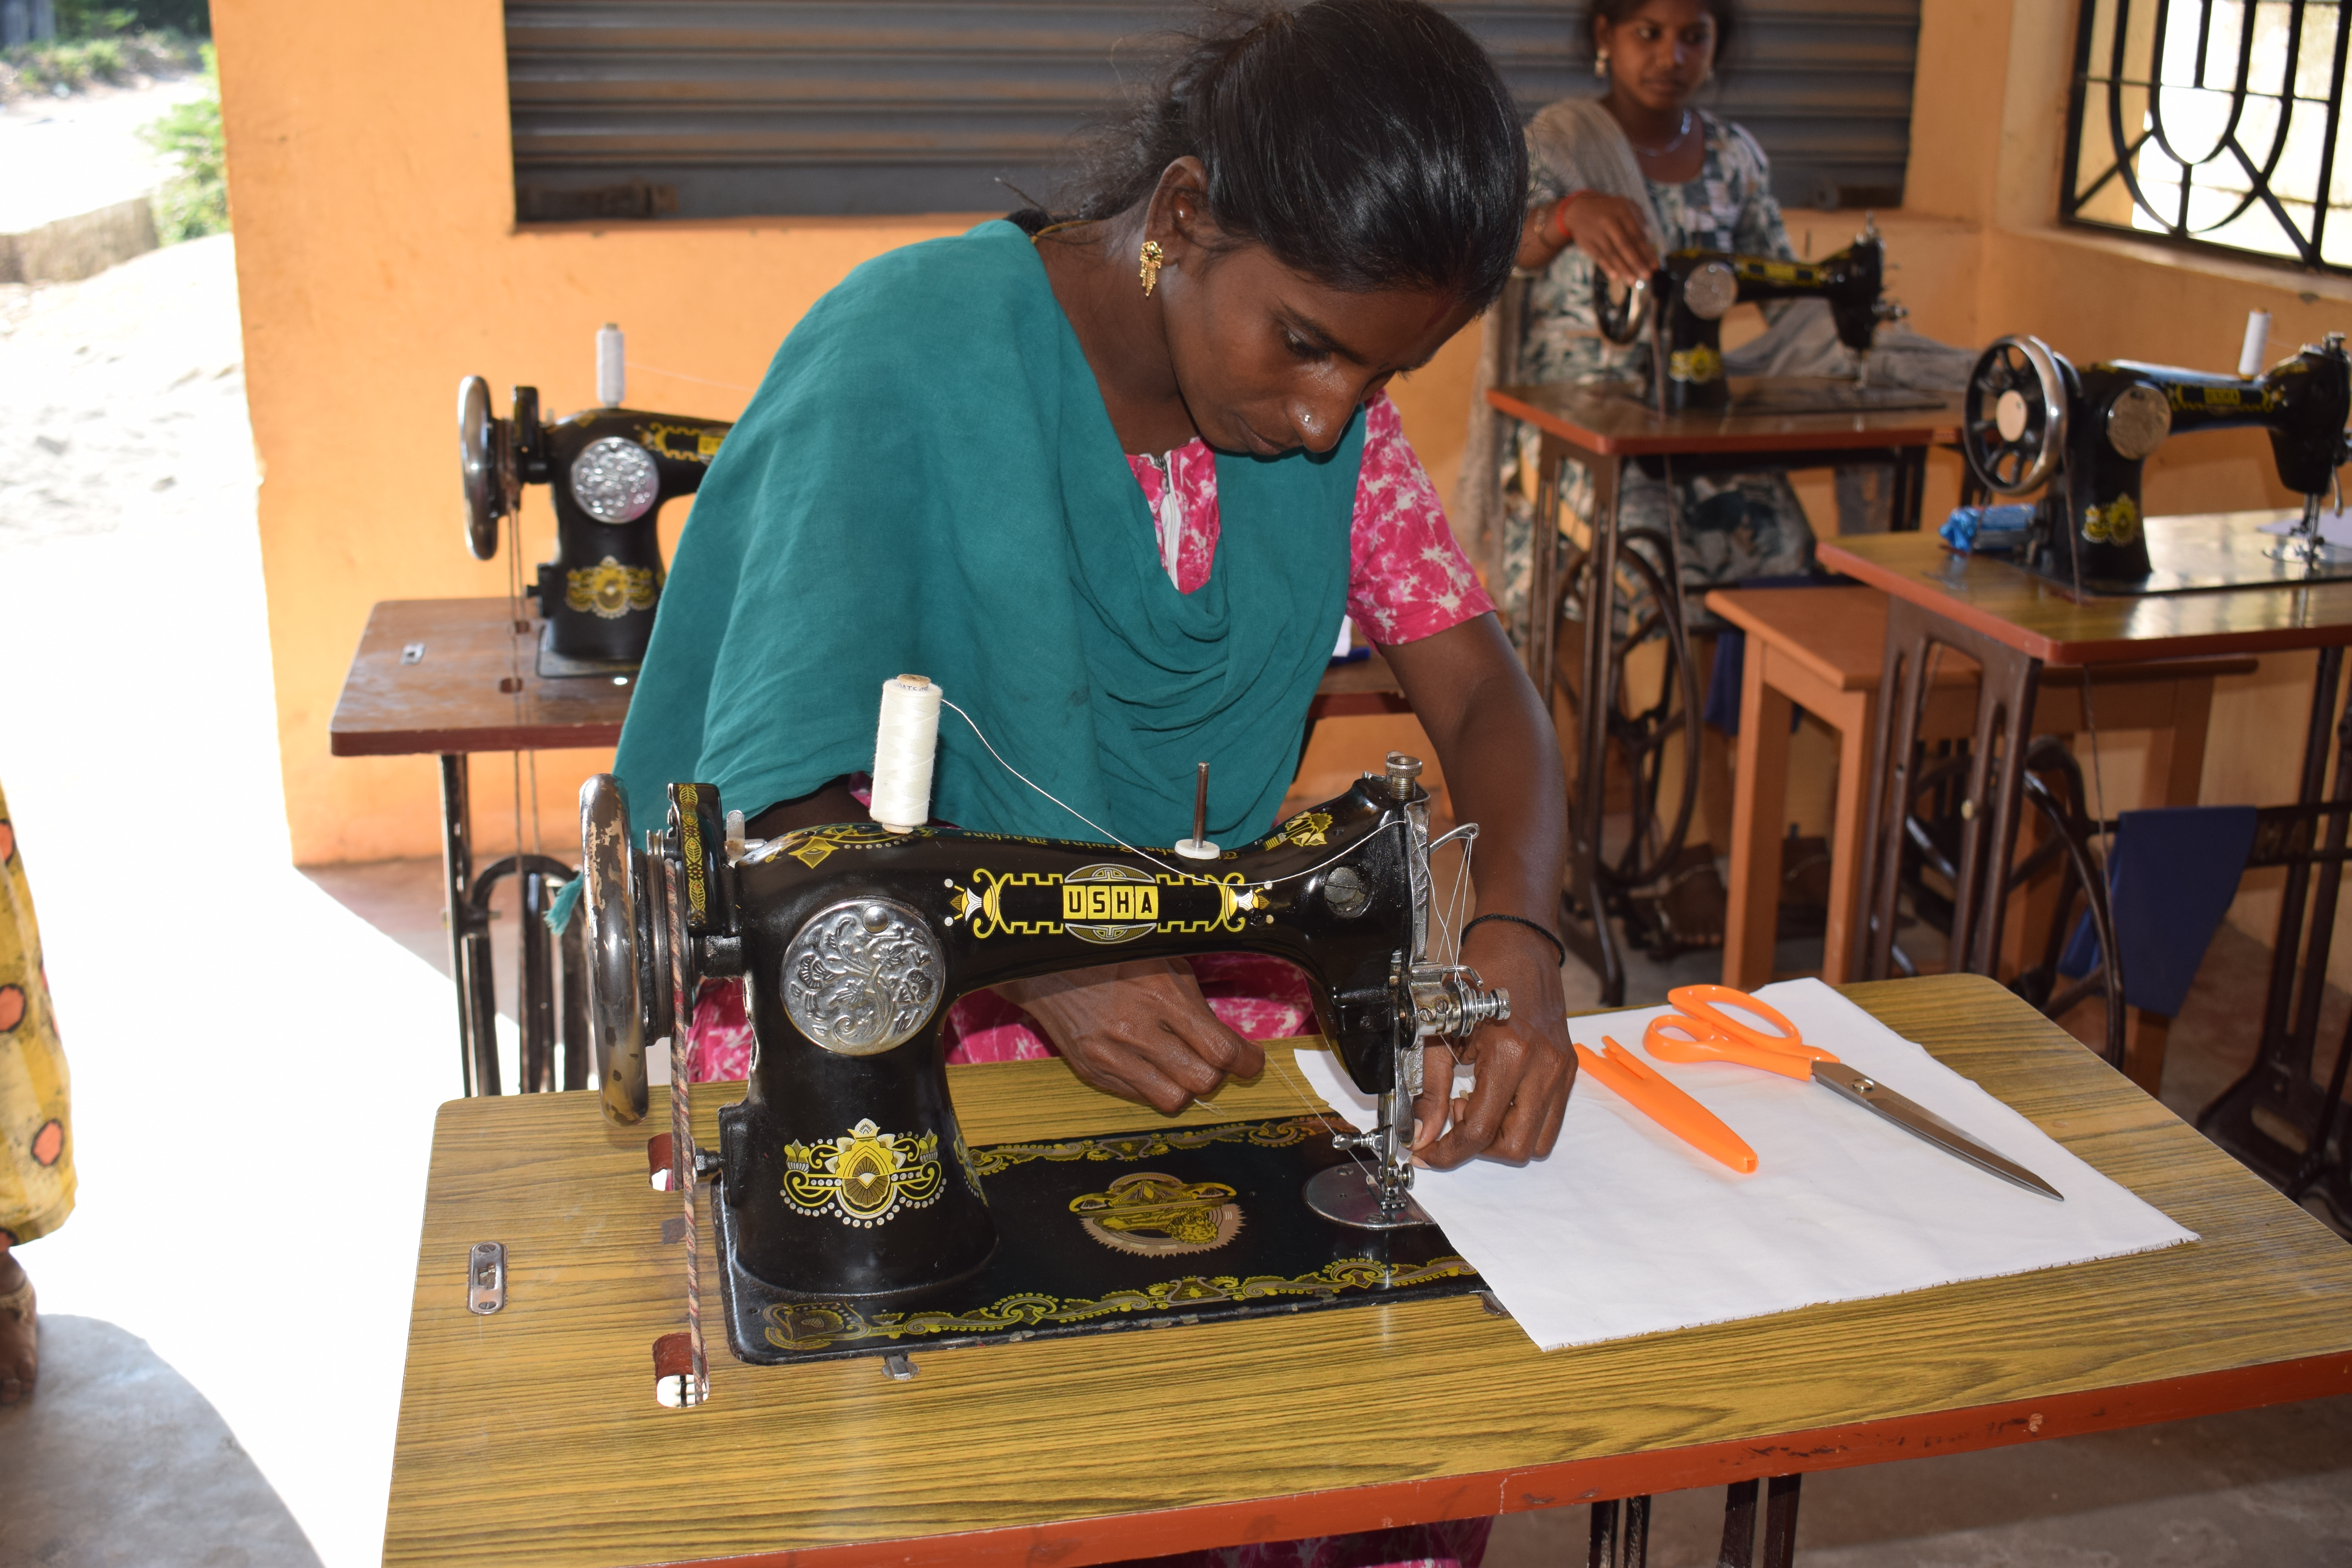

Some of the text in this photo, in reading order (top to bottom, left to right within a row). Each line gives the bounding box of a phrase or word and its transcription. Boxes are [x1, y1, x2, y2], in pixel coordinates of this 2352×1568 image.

[963, 831, 1048, 845] Machine
[1059, 839, 1135, 853] Sewing
[1068, 890, 1153, 914] USHA
